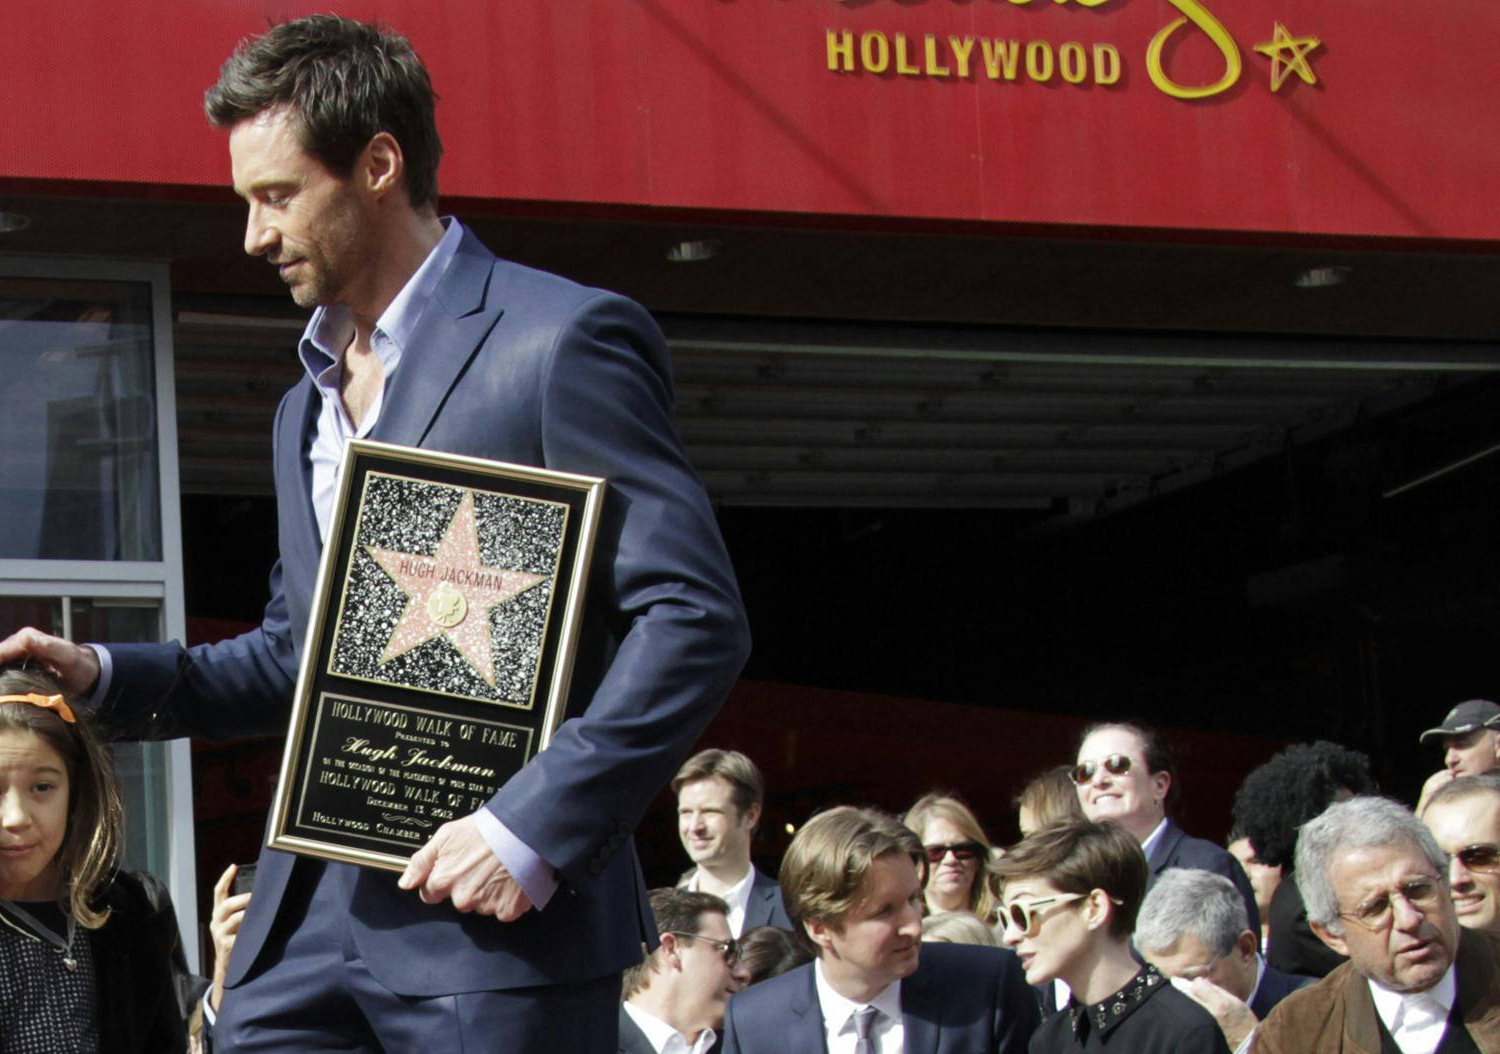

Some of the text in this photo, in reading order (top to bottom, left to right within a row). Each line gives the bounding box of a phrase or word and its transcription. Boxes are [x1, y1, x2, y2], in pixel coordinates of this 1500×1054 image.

[826, 28, 1121, 86] HOLLYWOOD
[400, 559, 503, 591] HUGH JACKMAN
[331, 701, 518, 748] HOLLYWOOD WALK OF FAME
[341, 736, 497, 778] Hugh Jackman
[319, 770, 396, 796] HOLLYWOOD
[404, 784, 441, 804] WALK
[448, 793, 465, 808] OF
[312, 811, 370, 831] HOLLYWOOD
[375, 822, 421, 841] CHAMBER
